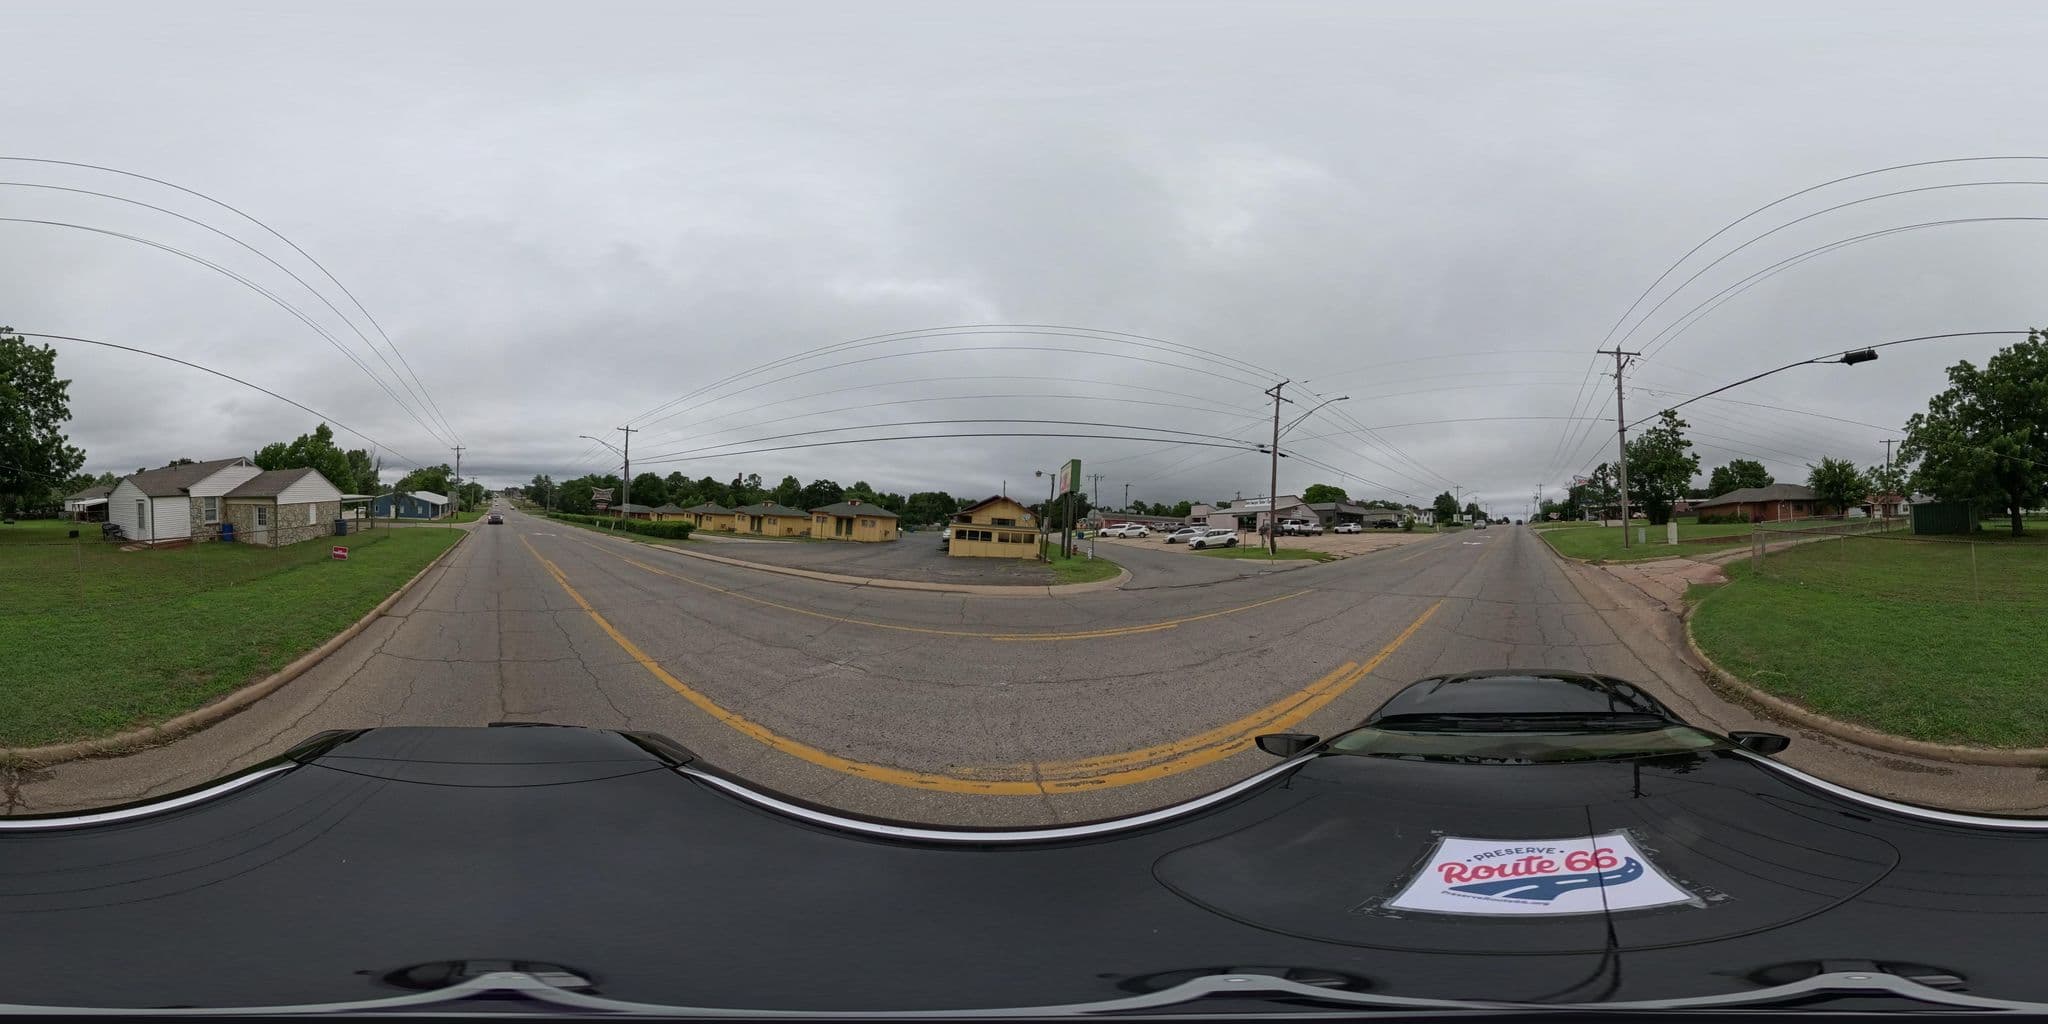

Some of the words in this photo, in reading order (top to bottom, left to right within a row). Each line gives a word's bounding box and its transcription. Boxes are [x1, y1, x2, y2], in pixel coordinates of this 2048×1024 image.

[1437, 855, 1560, 884] Route
[1564, 848, 1618, 872] 66
[1473, 847, 1557, 862] PRESERVE
